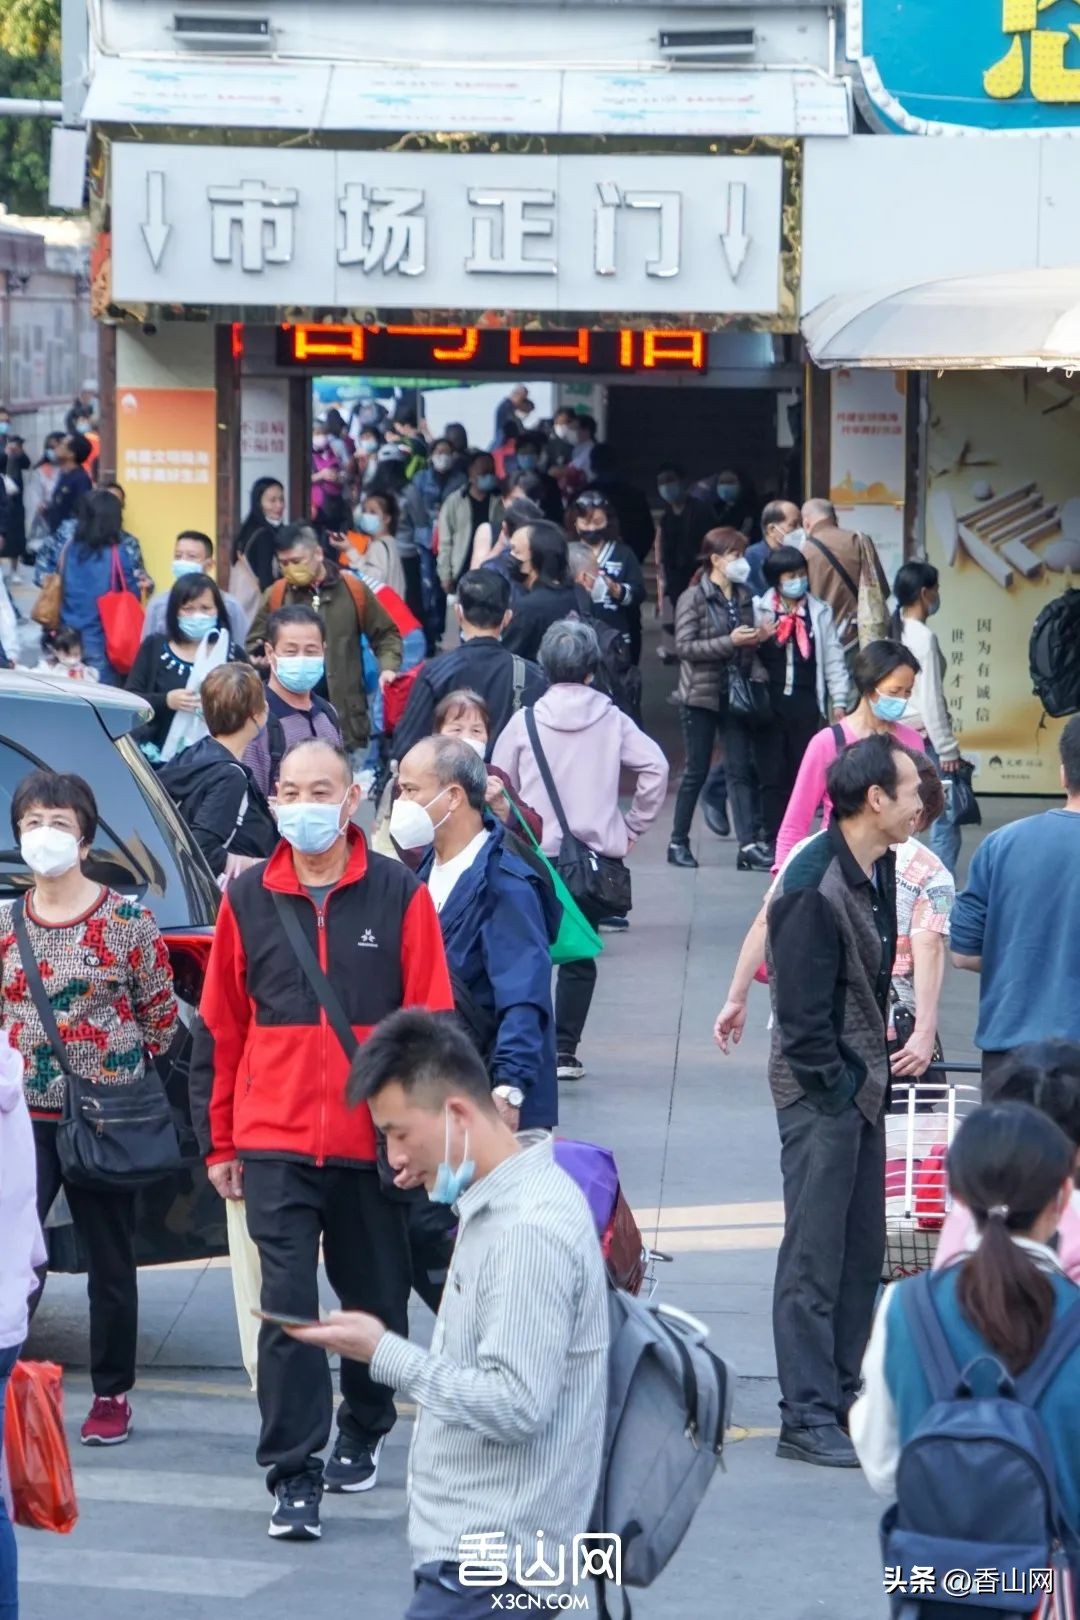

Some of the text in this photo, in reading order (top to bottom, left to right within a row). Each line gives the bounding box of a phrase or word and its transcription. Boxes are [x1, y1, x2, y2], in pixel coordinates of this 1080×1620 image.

[206, 179, 683, 276] 市场正门
[950, 628, 965, 733] 世界才可信
[976, 618, 992, 722] 因为有诚信
